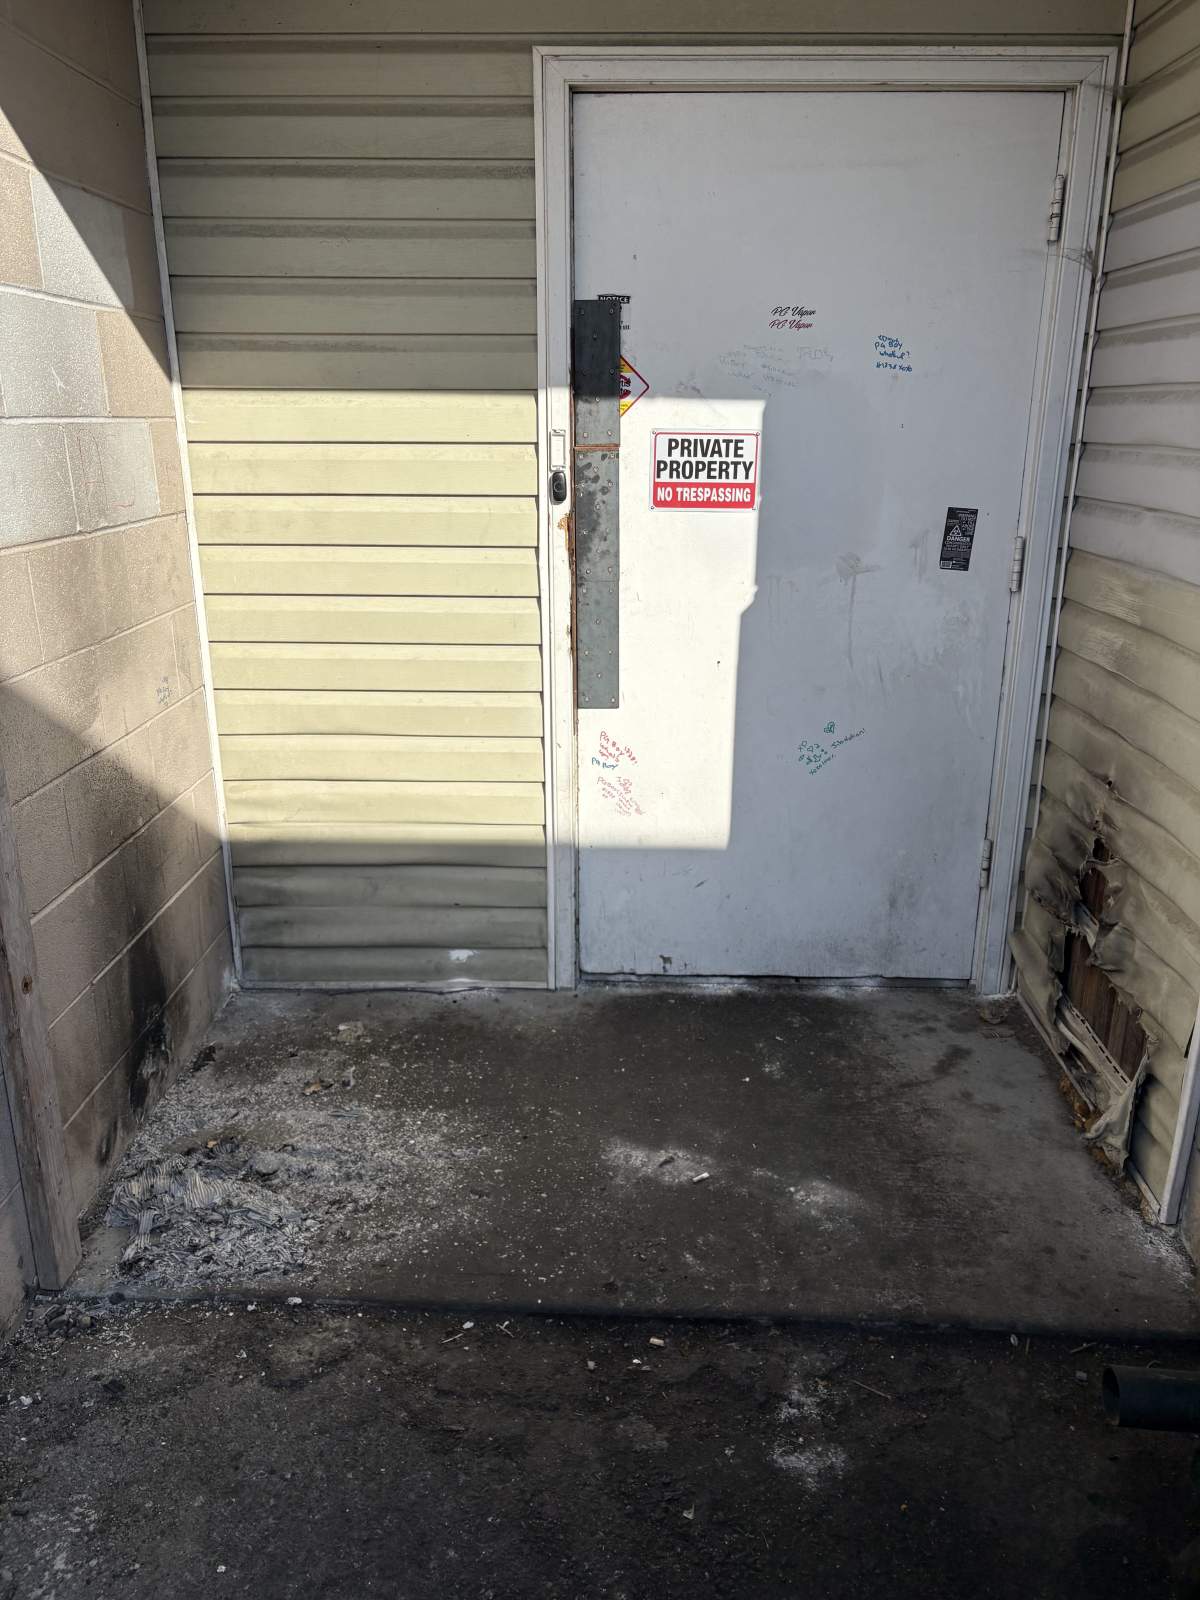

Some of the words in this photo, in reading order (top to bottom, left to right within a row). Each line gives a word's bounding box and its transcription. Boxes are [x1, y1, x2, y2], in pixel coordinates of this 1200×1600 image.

[667, 438, 745, 458] PRIVATE
[656, 460, 754, 480] PROPERTY
[657, 487, 673, 501] NO
[676, 487, 751, 502] TRESPASSING
